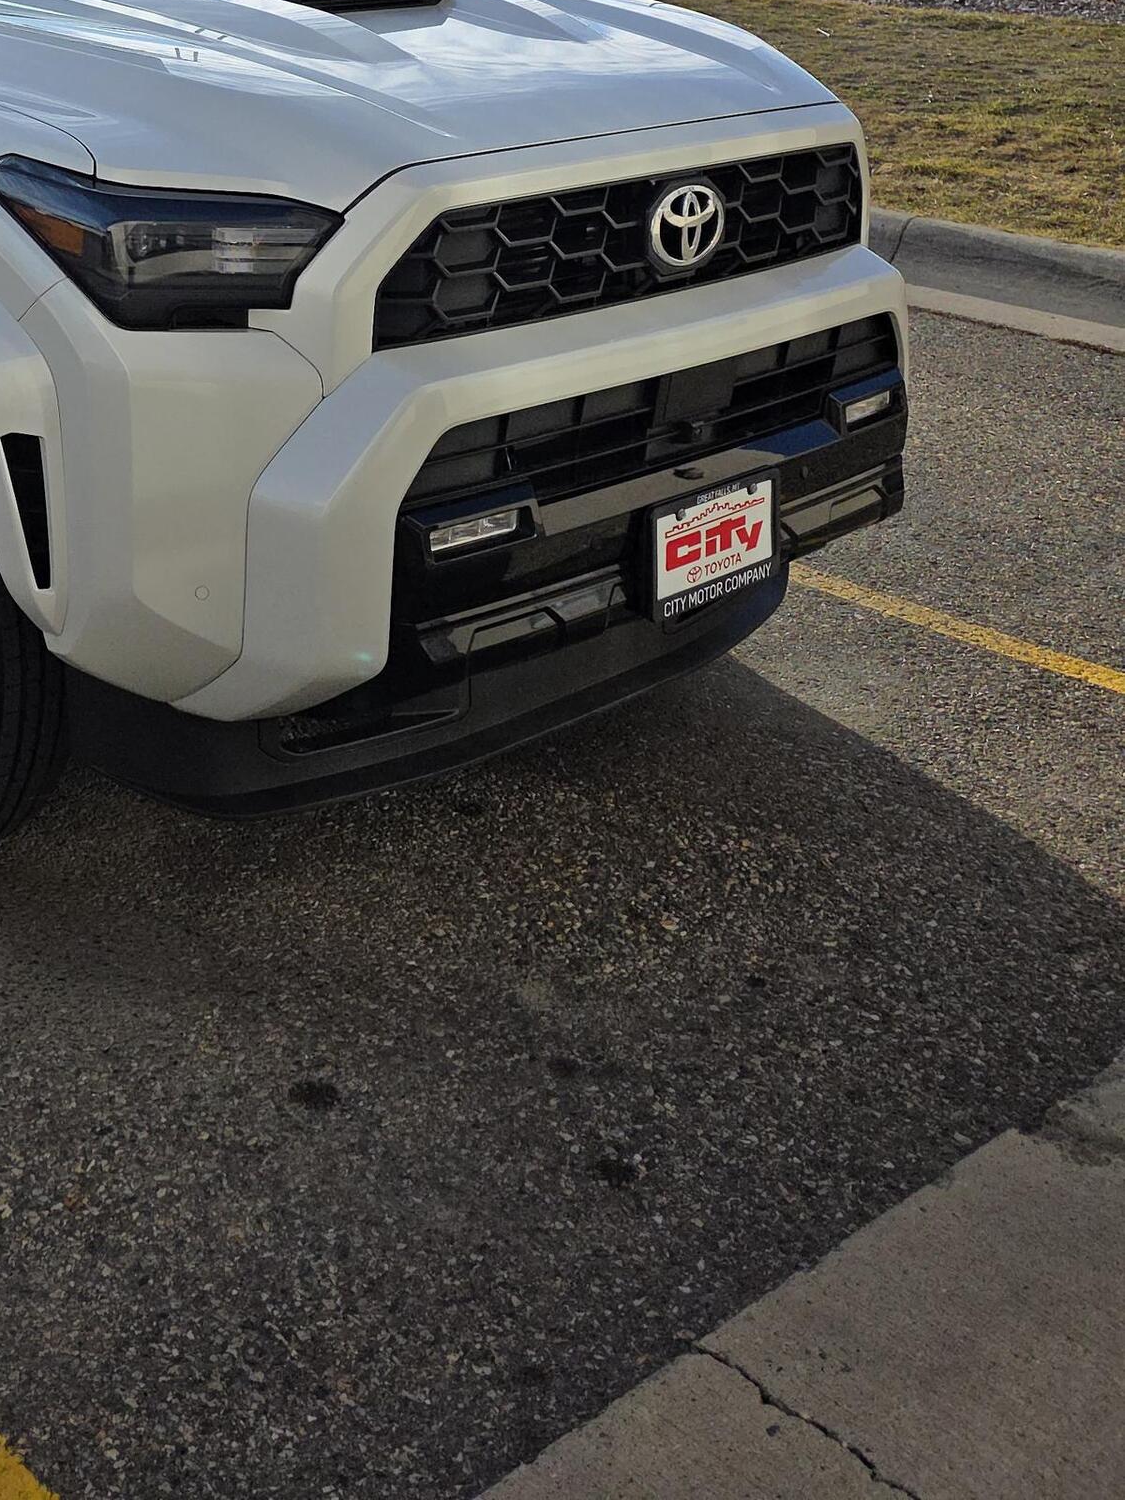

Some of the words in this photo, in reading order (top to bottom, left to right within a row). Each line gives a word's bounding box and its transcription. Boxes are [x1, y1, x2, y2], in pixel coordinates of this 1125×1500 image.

[696, 490, 715, 505] GREAT
[704, 552, 742, 577] TOYOTA
[663, 597, 688, 618] CITY
[688, 581, 723, 609] MOTOR
[724, 562, 772, 594] COMPANY
